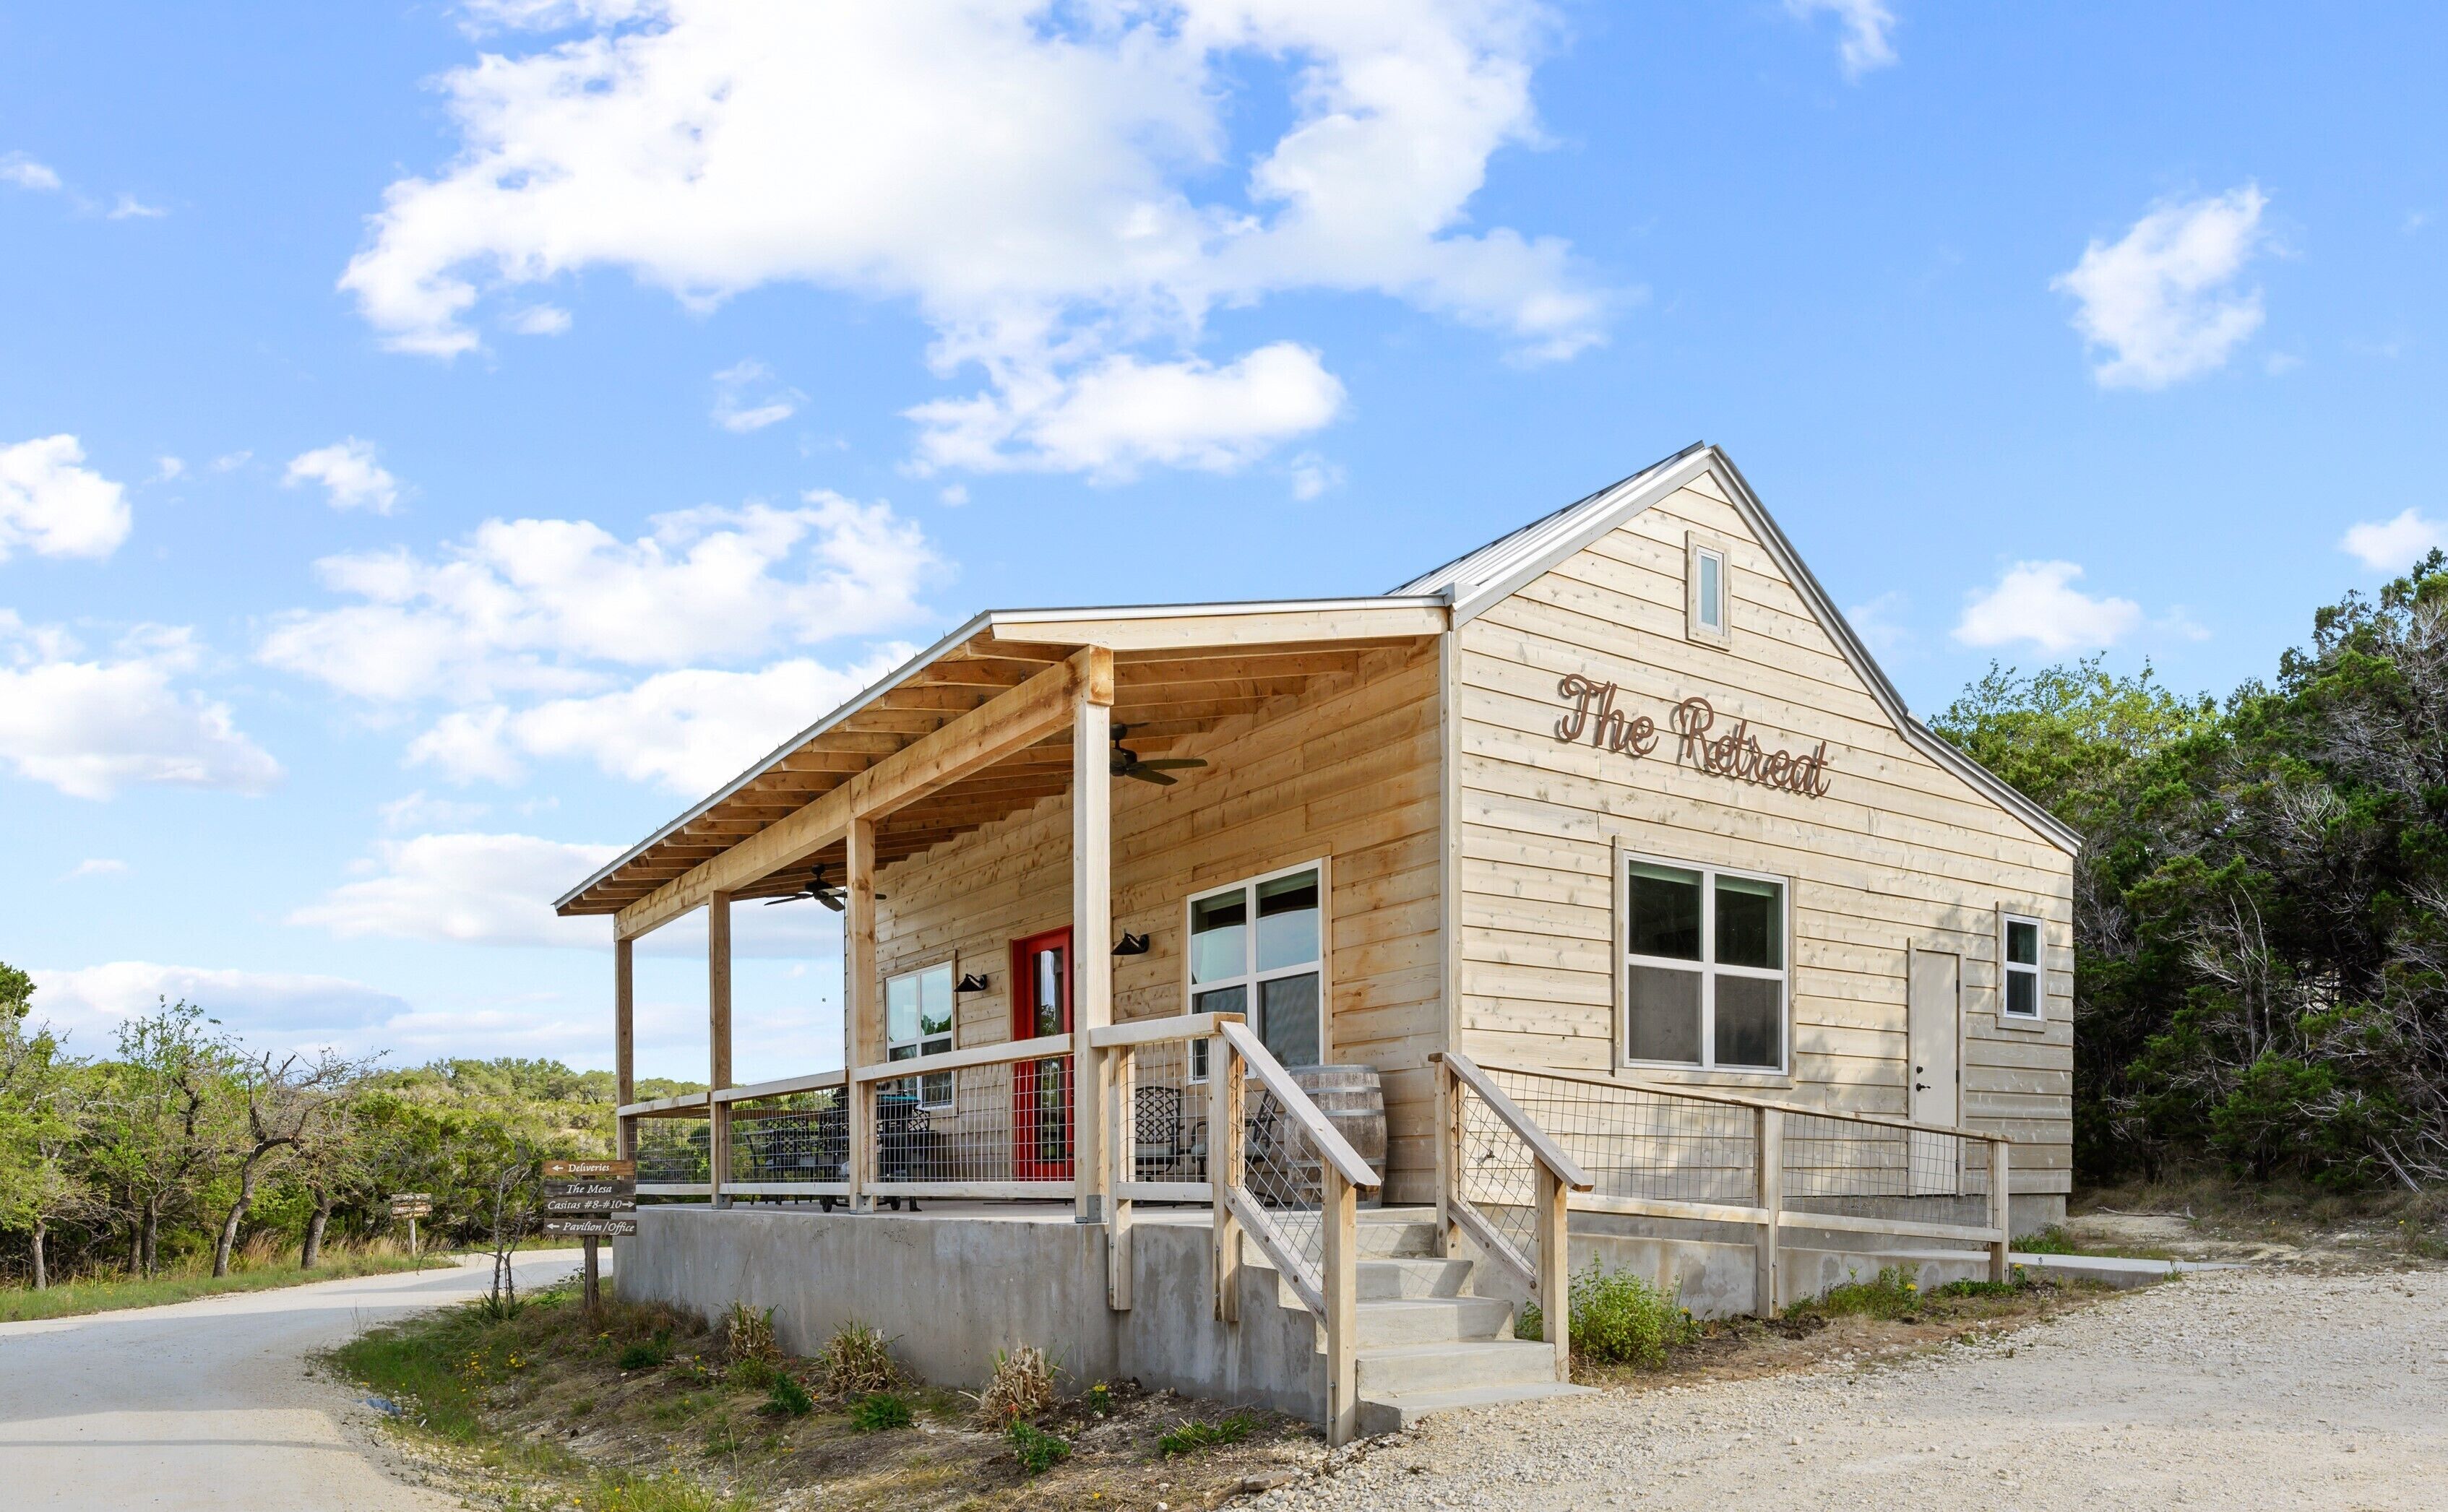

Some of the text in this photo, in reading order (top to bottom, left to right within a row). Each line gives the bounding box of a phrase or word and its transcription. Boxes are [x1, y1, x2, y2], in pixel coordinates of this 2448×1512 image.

[1561, 673, 1832, 797] The Retreat
[568, 1162, 610, 1172] Deliveries
[566, 1183, 613, 1194] The Mesa
[548, 1200, 623, 1210] Casitas #8-#10
